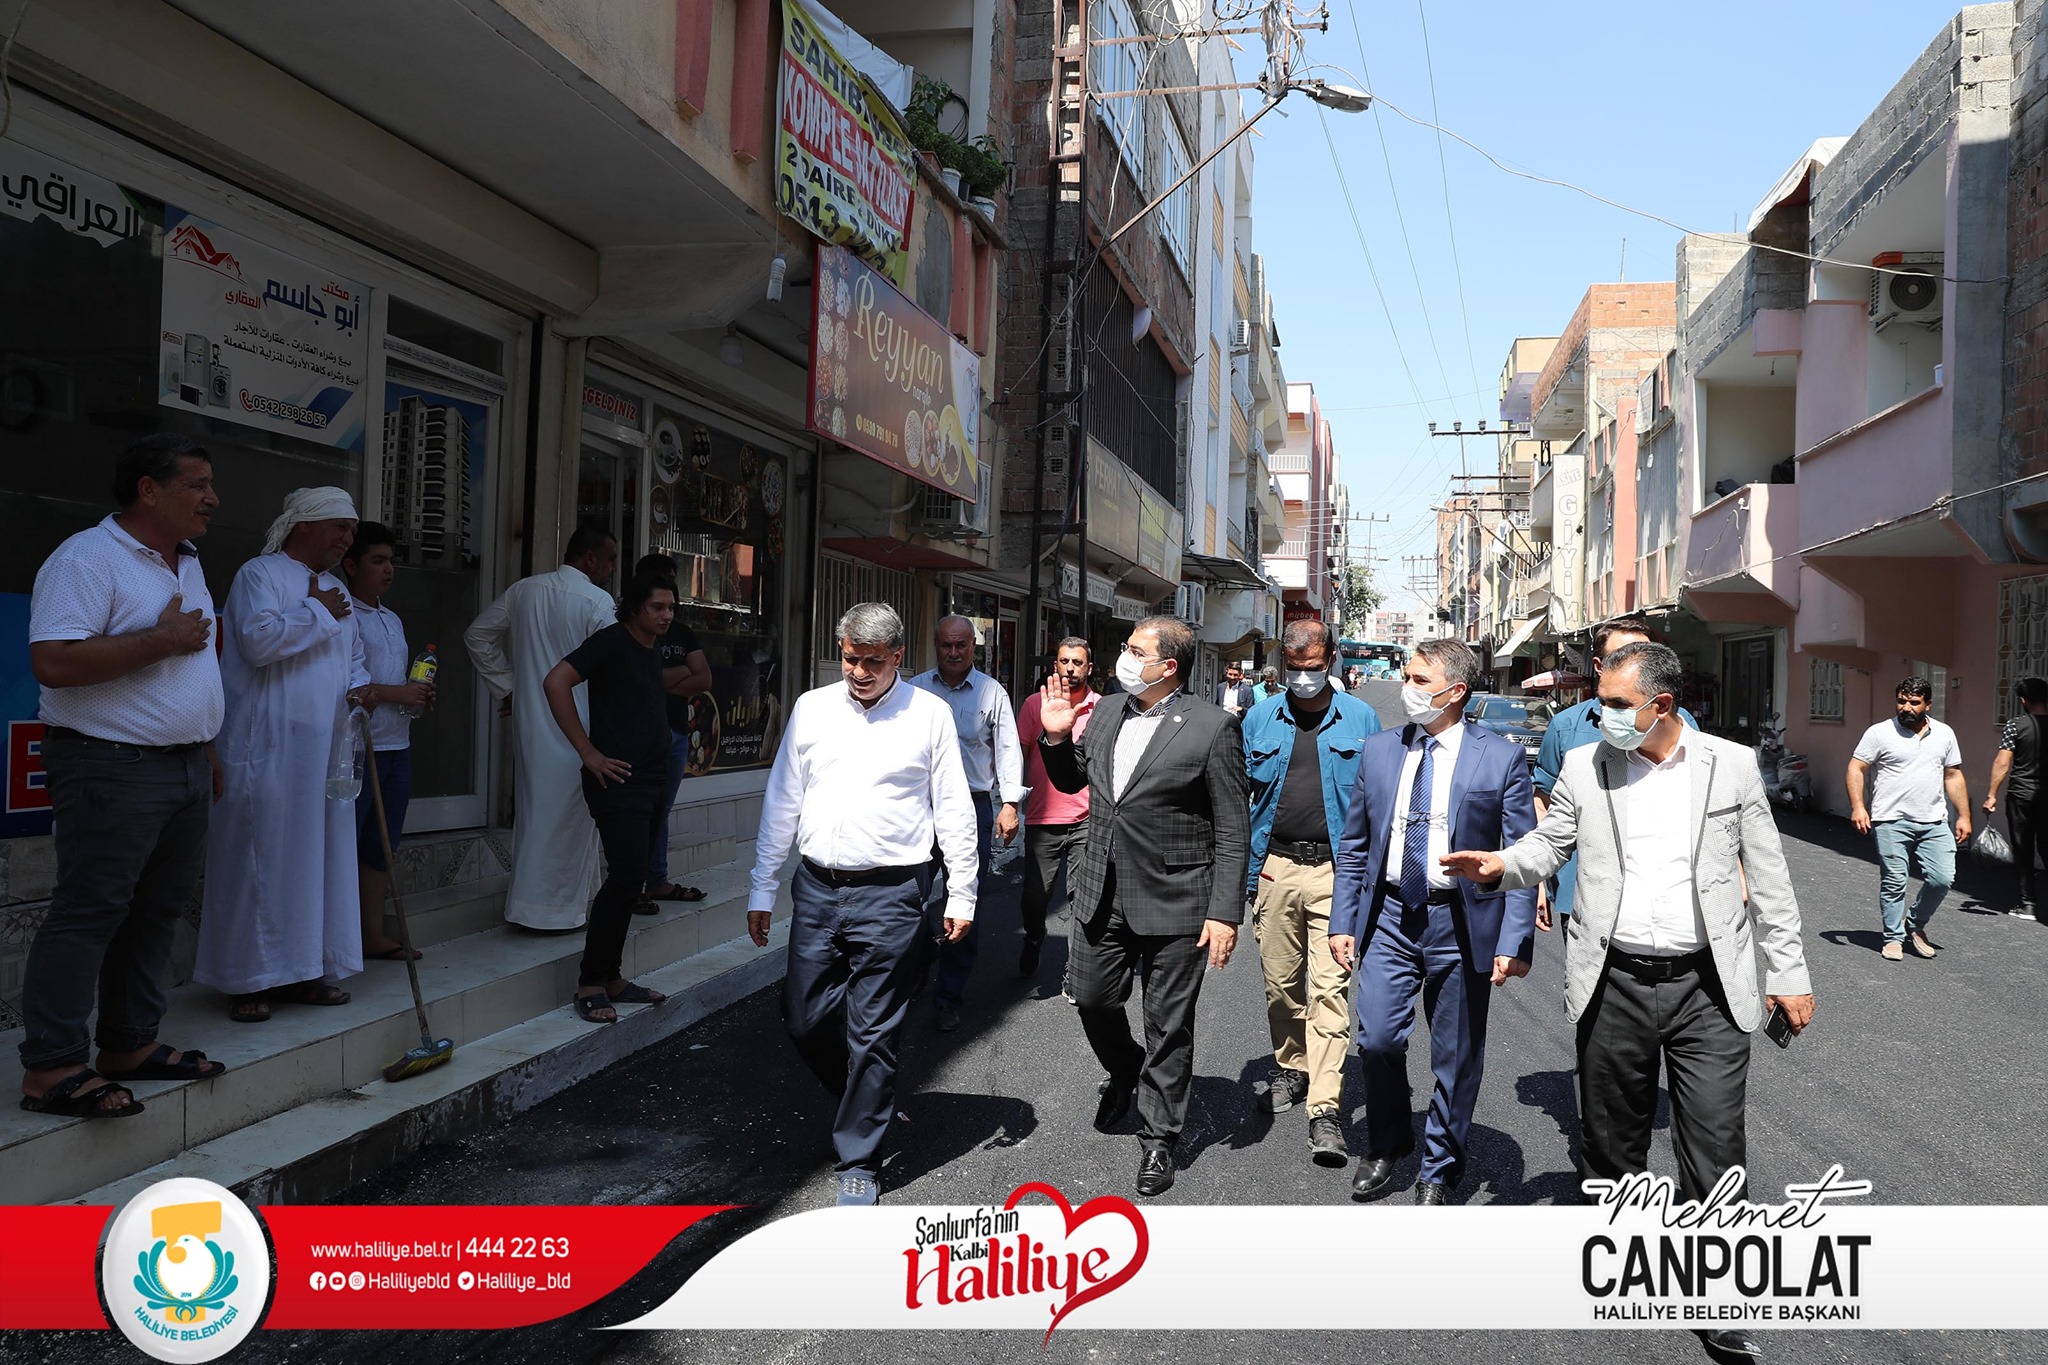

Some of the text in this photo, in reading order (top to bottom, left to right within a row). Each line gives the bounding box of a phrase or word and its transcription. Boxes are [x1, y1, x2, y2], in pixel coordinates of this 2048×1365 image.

[783, 58, 856, 173] KOMPLE
[787, 142, 798, 168] 2
[2, 172, 139, 239] العراقي
[779, 173, 841, 239] 0543
[321, 281, 350, 301] مكتب
[225, 279, 360, 337] أبو جاسم العقاري
[260, 330, 286, 345] عقارات
[853, 271, 945, 394] Reyyan
[223, 334, 258, 354] المستعملة
[292, 338, 319, 356] العقارات
[319, 349, 337, 363] وشراء
[338, 355, 352, 366] بيع
[311, 362, 327, 375] كافة
[327, 370, 344, 383] وشراء
[346, 375, 359, 387] بيع
[253, 395, 328, 428] 0542 298 26 52
[1555, 468, 1582, 488] ASİYE
